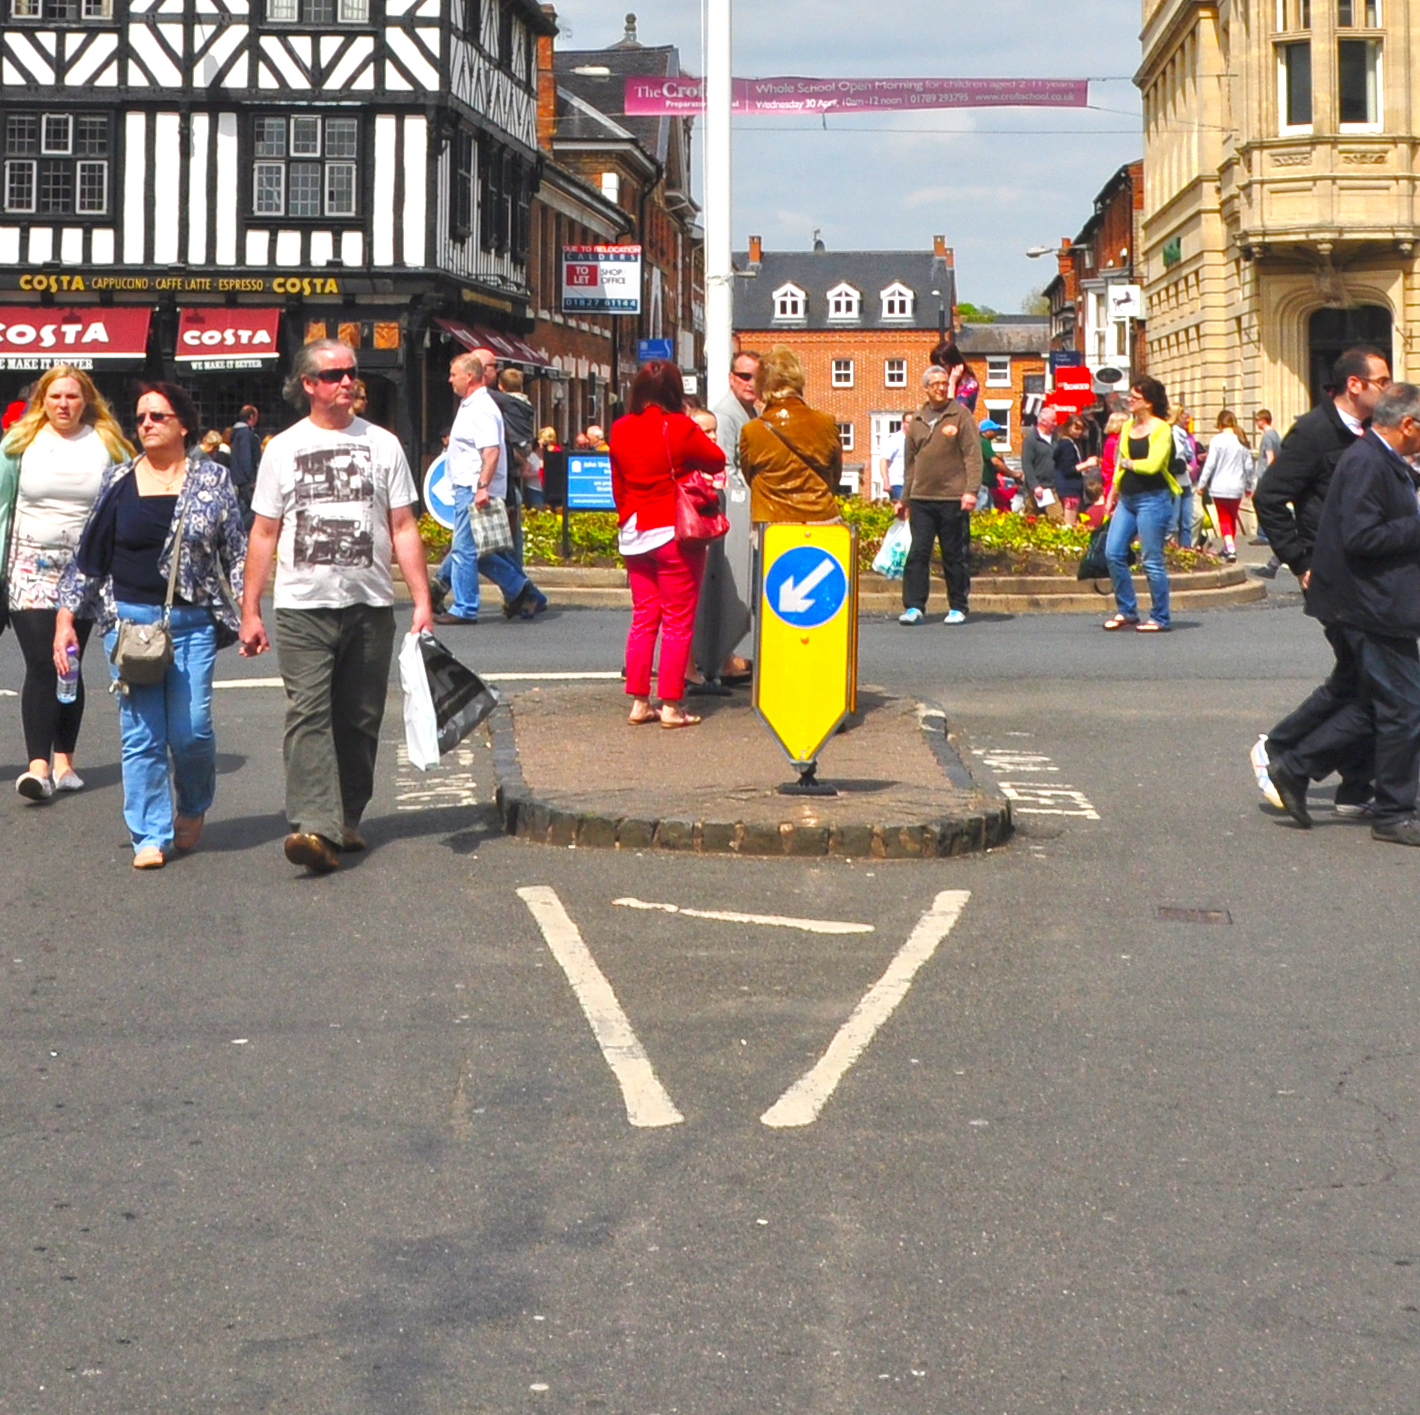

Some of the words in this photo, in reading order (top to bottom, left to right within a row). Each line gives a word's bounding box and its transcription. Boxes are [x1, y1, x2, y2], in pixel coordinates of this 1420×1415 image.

[635, 84, 661, 98] The
[756, 83, 795, 94] Whole
[797, 82, 836, 94] School
[838, 81, 872, 94] Open
[874, 81, 923, 92] Morning
[925, 80, 940, 88] for
[943, 80, 987, 89] children
[989, 81, 1016, 90] aged
[1045, 81, 1075, 90] years
[755, 100, 804, 111] Wednesday
[805, 98, 816, 108] 30
[880, 96, 902, 105] noon
[580, 245, 592, 253] TO
[566, 253, 636, 261] CALDERS
[575, 266, 589, 275] TO
[573, 275, 590, 284] LET
[600, 277, 626, 285] OFFICE
[19, 274, 85, 294] COSTA
[91, 277, 149, 290] CAPPUCCINO
[184, 278, 212, 291] LATTE
[218, 279, 264, 292] ESPRESSO
[272, 276, 339, 296] COSTA
[182, 328, 272, 346] COSTA
[7, 358, 39, 370] MAKE
[40, 358, 52, 370] IT
